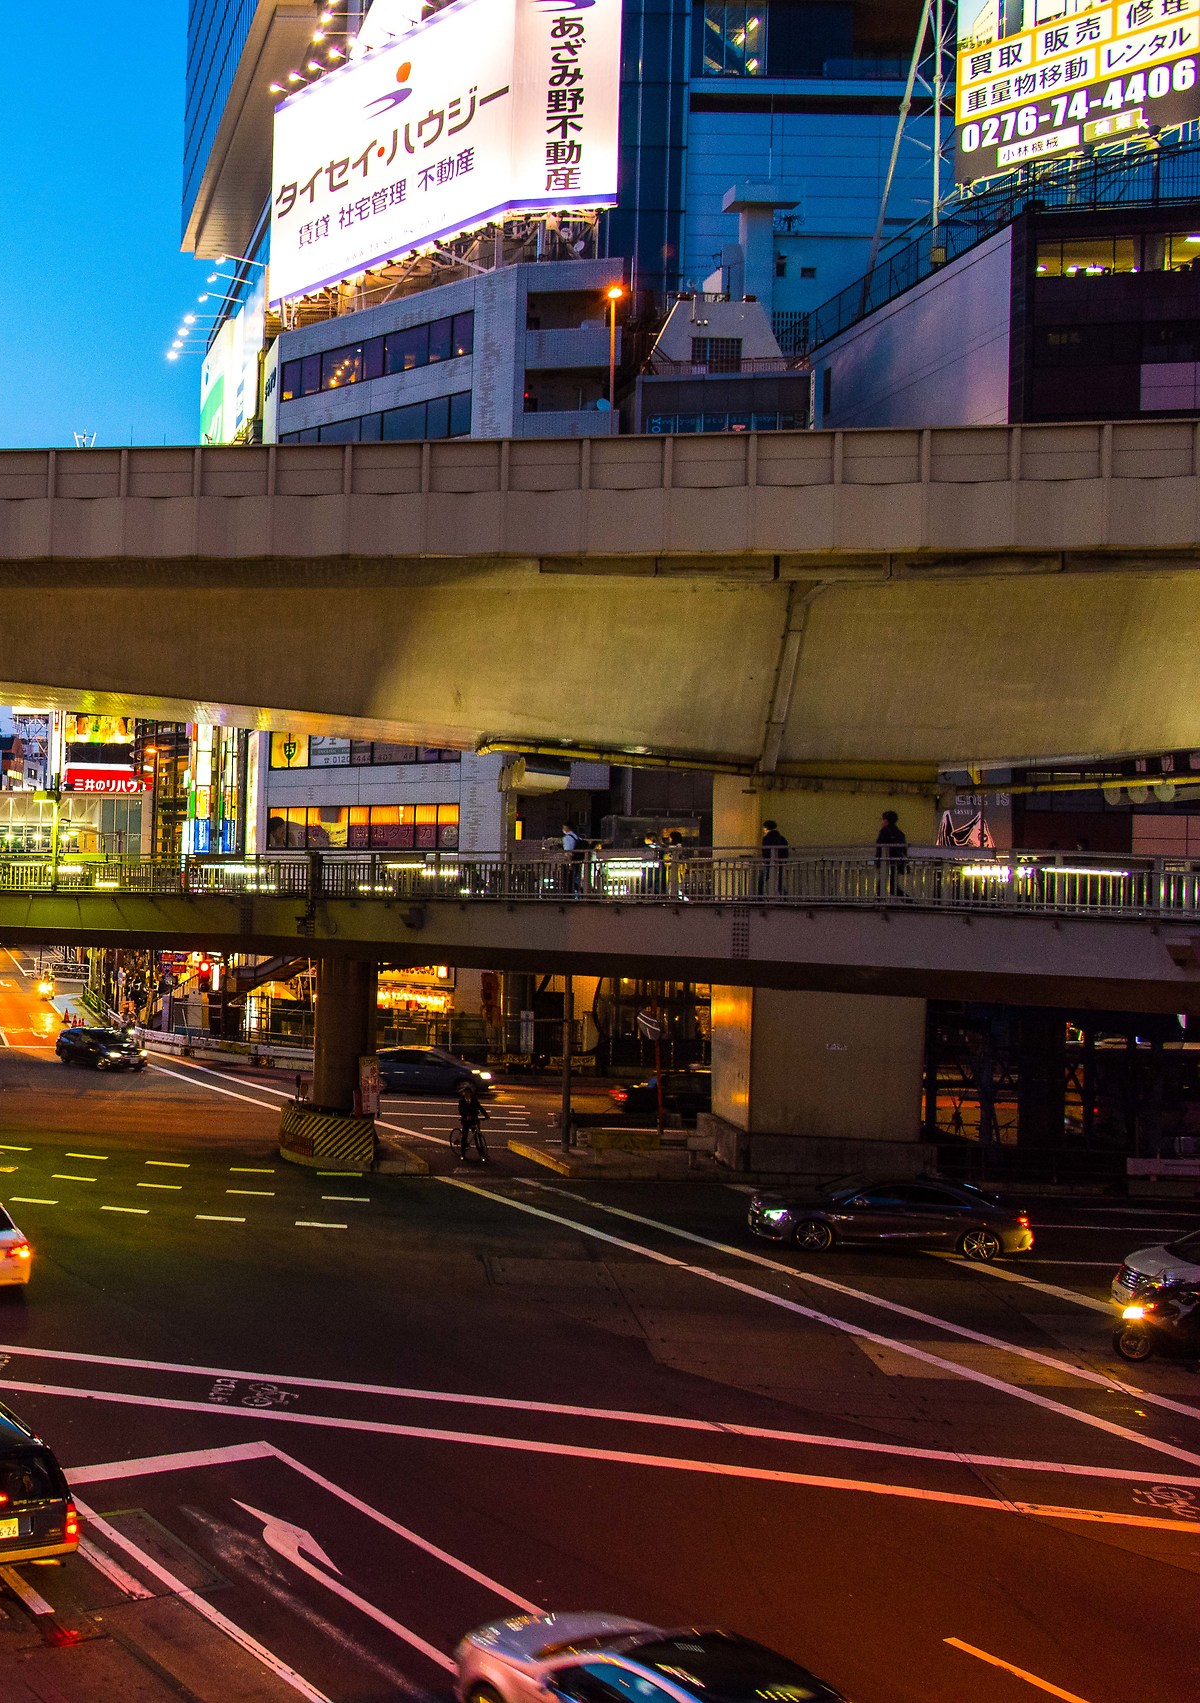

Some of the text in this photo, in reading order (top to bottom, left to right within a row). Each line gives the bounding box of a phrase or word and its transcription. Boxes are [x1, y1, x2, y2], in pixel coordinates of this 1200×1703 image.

[1043, 16, 1102, 56] 販売
[1107, 27, 1192, 68] レンタル
[966, 56, 1088, 113] 重量物移動
[969, 42, 1023, 80] 買取
[544, 16, 585, 191] あざみ野不動産
[961, 58, 1196, 153] 0276-74-4406
[276, 85, 509, 219] タイセイ・ハウジー
[1002, 136, 1059, 163] 小林機械
[298, 147, 475, 249] 賃貸 社宅管理 不動産
[354, 826, 433, 841] 歯科タナカ
